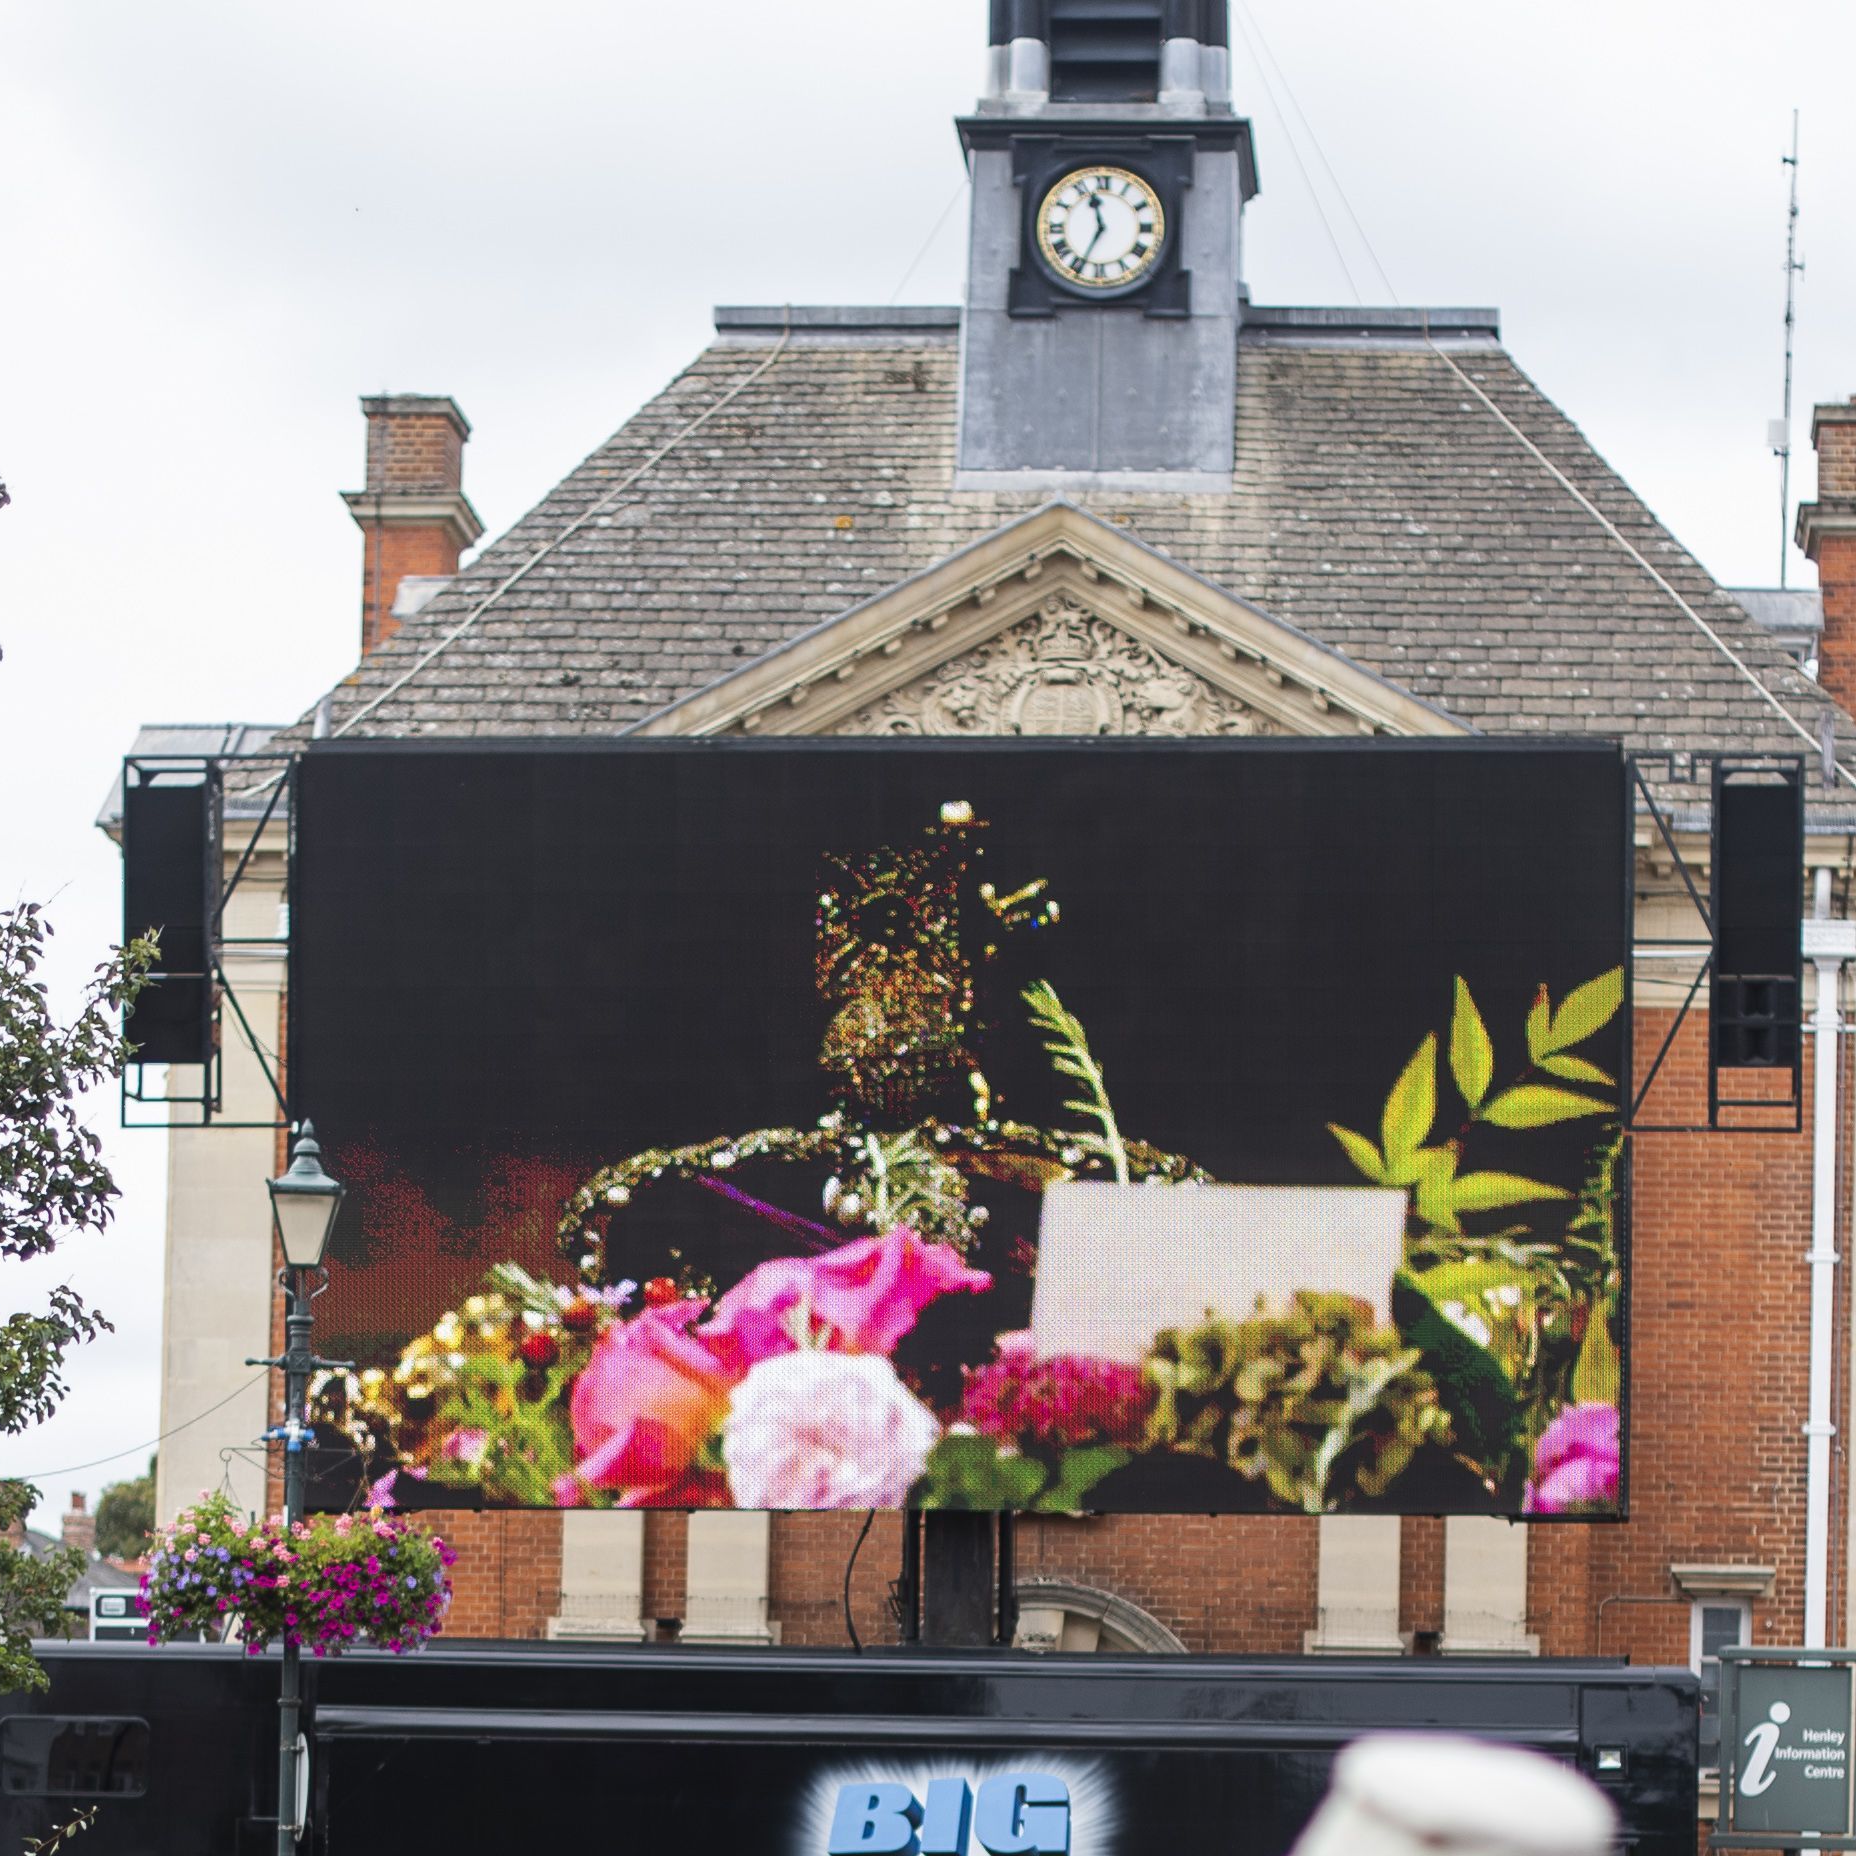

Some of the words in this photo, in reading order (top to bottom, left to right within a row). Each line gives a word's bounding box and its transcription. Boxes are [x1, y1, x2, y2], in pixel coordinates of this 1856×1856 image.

[1802, 1728, 1846, 1746] Henley
[1774, 1745, 1846, 1761] Information
[1804, 1764, 1846, 1779] Centre
